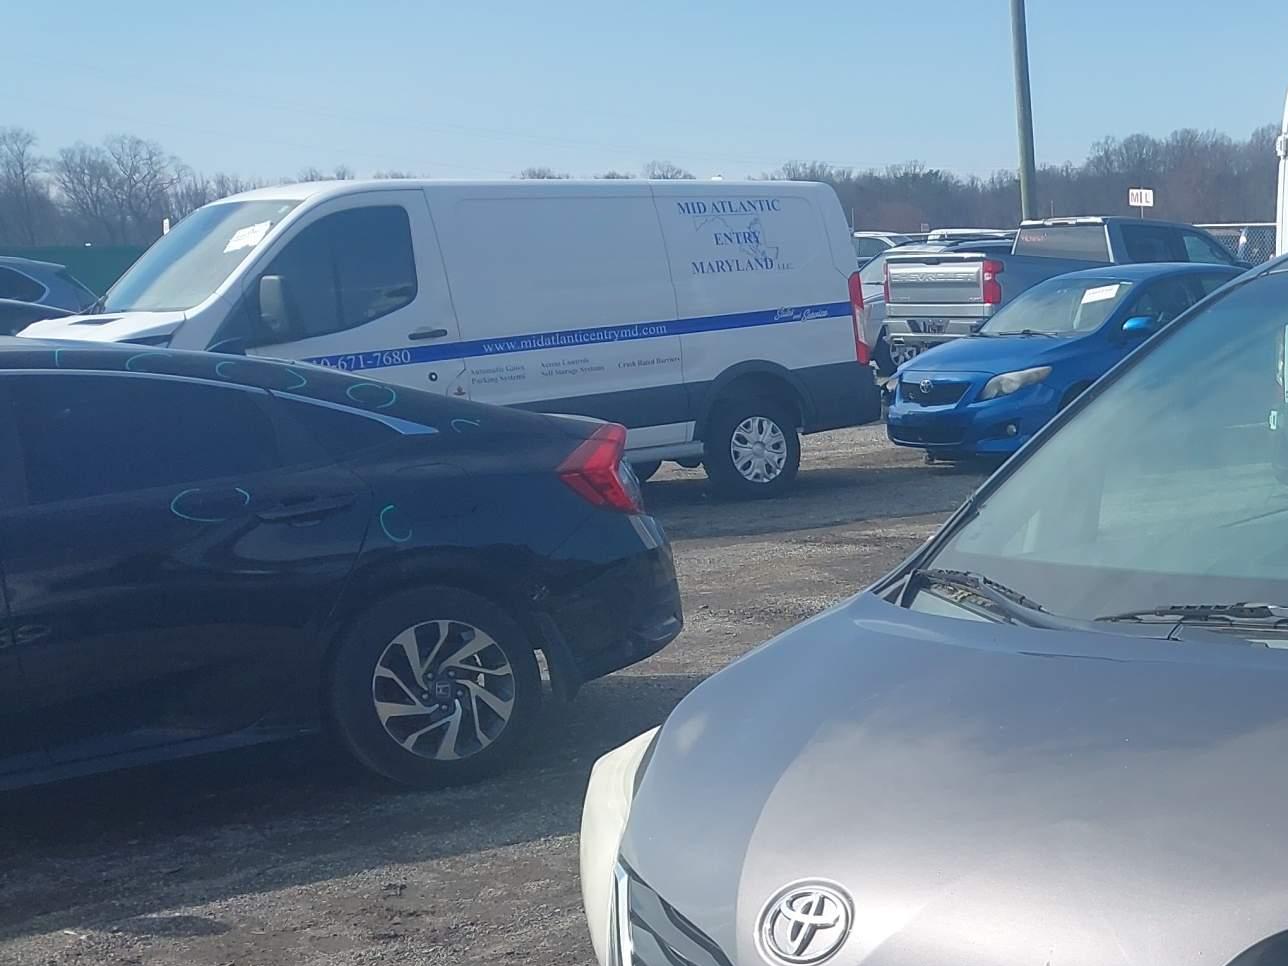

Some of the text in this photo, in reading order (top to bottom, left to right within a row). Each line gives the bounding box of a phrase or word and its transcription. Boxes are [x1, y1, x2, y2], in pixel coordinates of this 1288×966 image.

[677, 199, 782, 216] MID ATLANTIC
[713, 230, 761, 246] ENTRY
[691, 257, 774, 275] MARYLAND
[482, 324, 668, 354] www.midatlanticentrymd.com
